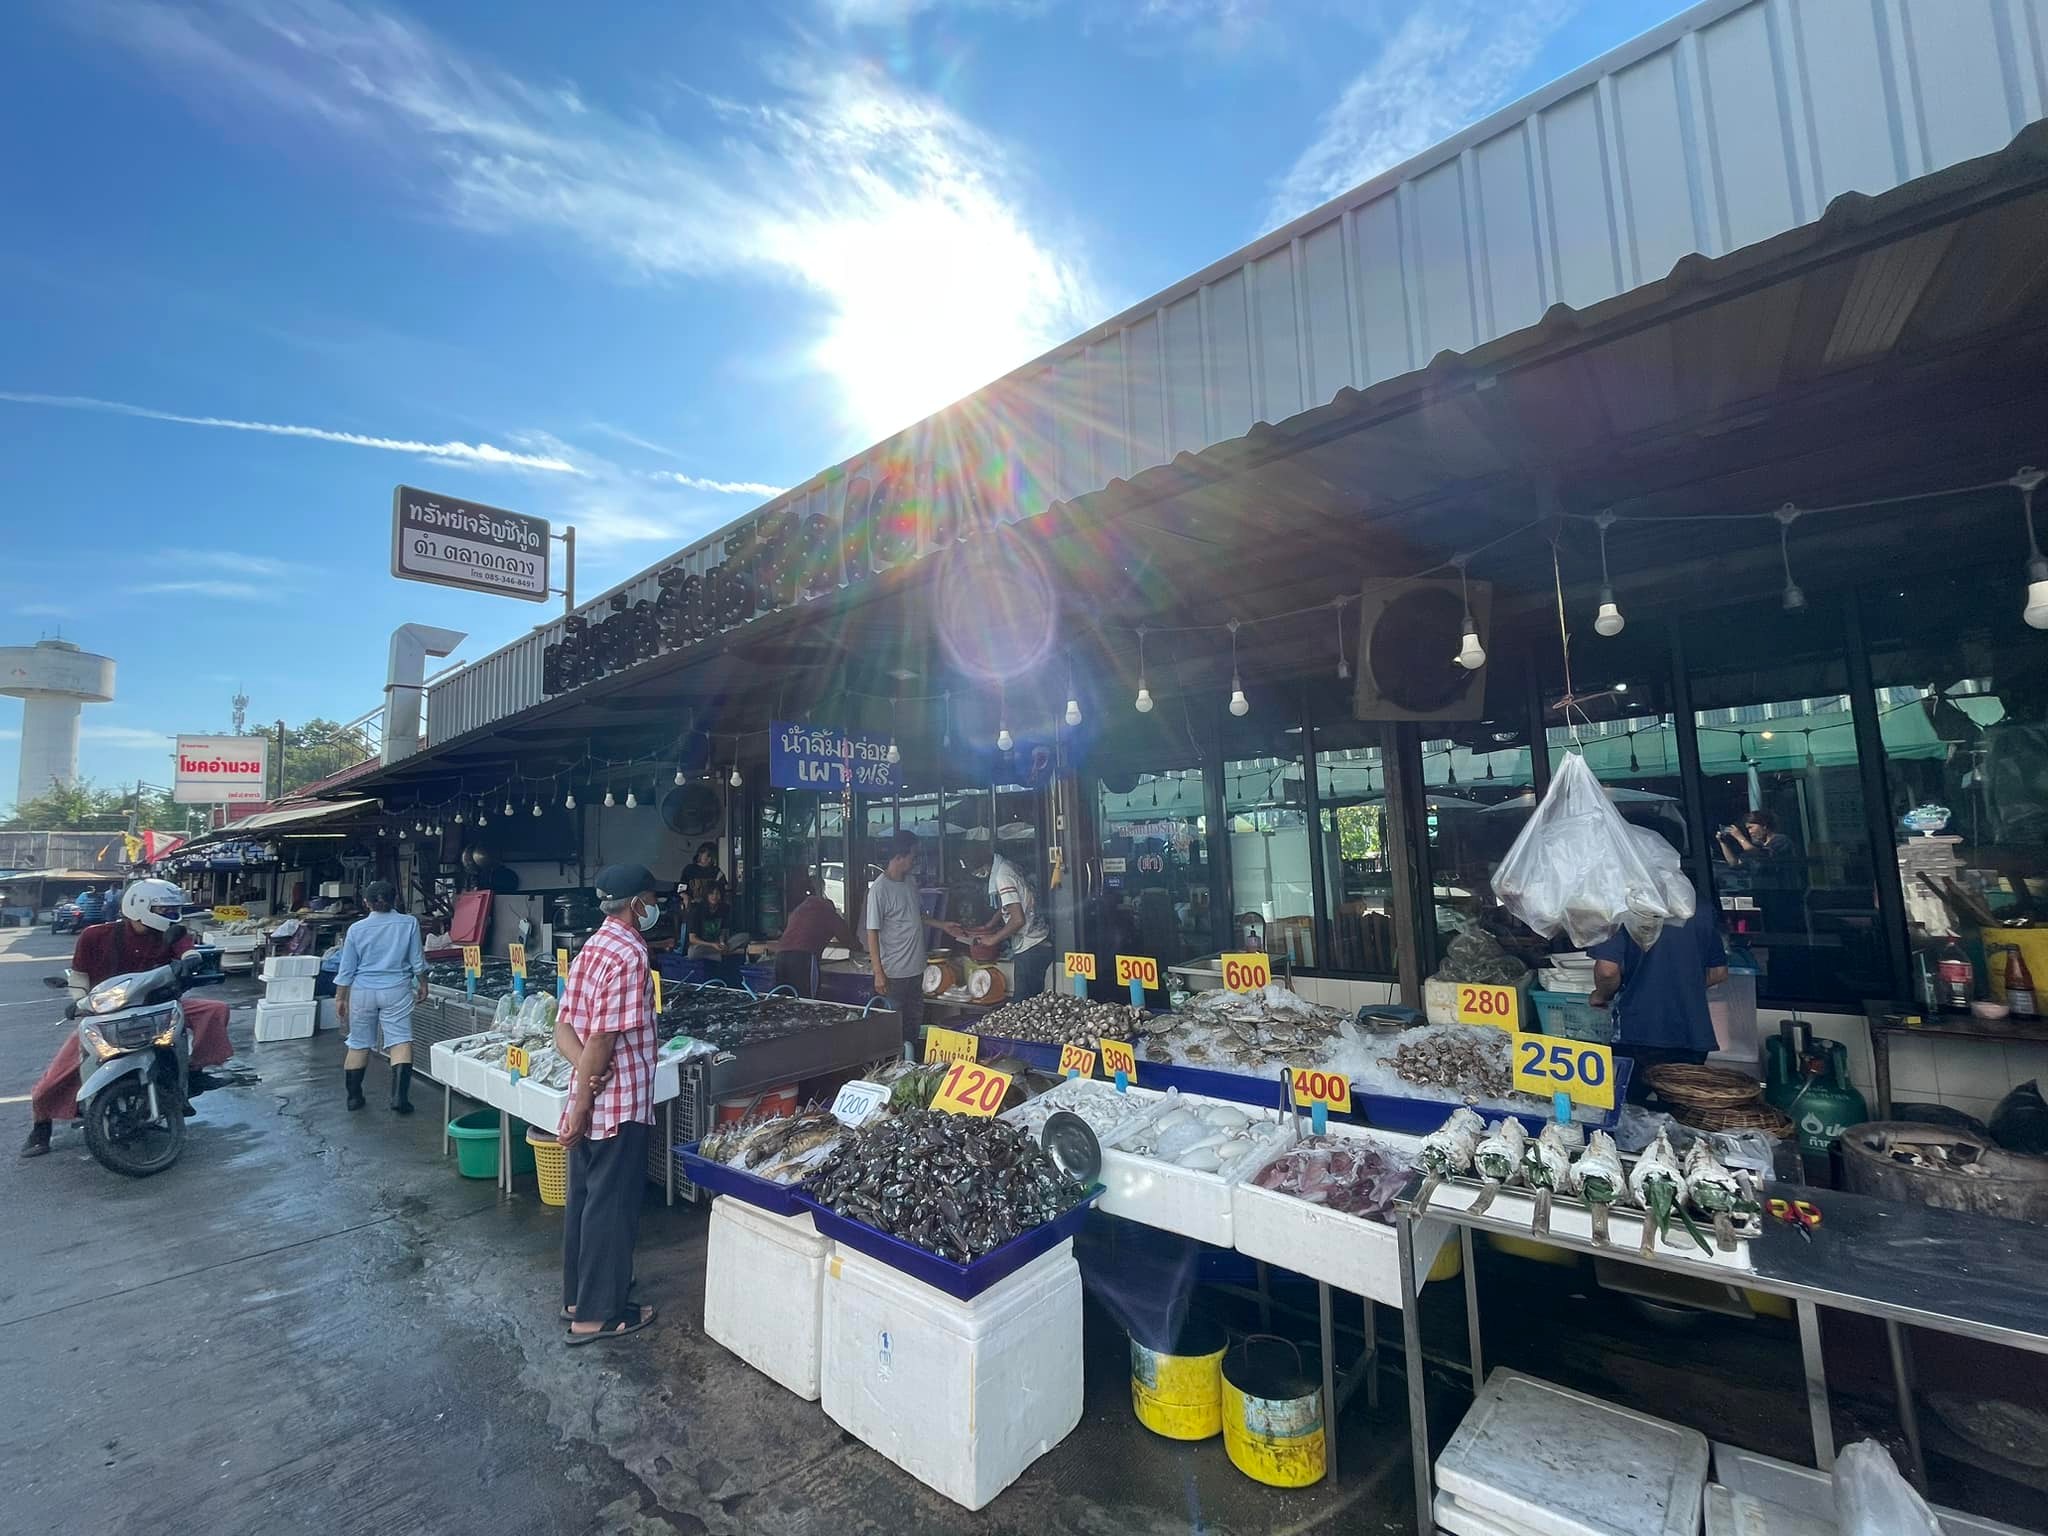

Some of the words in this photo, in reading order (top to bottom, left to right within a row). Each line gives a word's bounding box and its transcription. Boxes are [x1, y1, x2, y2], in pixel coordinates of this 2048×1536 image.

[409, 502, 540, 552] ทรัพย์เจริญซีฟู้ด
[414, 533, 437, 556] ดำ
[443, 544, 535, 576] ตลาดกลาง
[180, 754, 260, 773] โชคอำนวย
[465, 947, 479, 967] 350
[511, 946, 524, 967] 400
[1067, 954, 1092, 973] 280
[1120, 959, 1155, 983] 300
[1226, 961, 1267, 990] 600
[1462, 988, 1510, 1016] 280
[510, 1049, 522, 1068] 50
[1062, 1046, 1093, 1074] 320
[1105, 1047, 1133, 1074] 380
[1520, 1041, 1605, 1086] 250
[944, 1064, 1005, 1112] 120
[1295, 1070, 1345, 1102] 400
[837, 1093, 869, 1116] 1200
